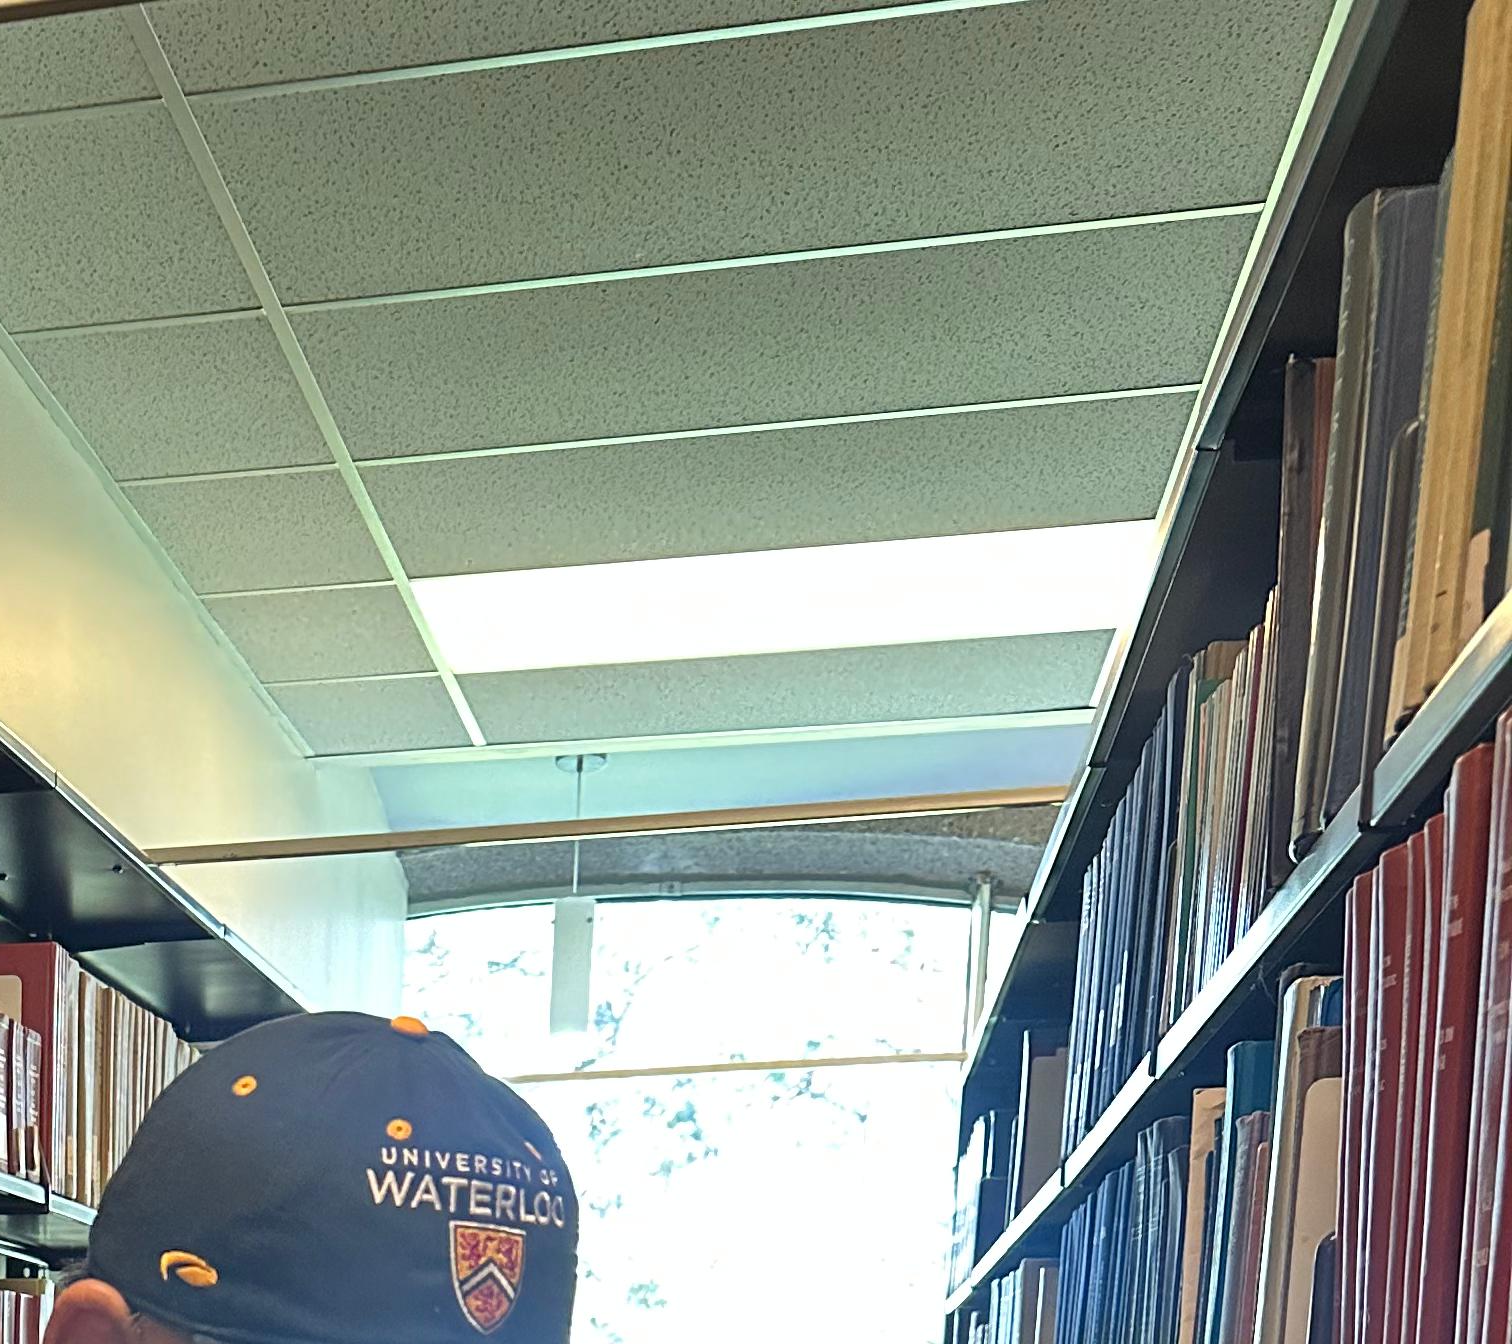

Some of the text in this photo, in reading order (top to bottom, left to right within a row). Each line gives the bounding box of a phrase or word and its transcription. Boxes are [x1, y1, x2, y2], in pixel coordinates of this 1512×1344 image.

[380, 1146, 559, 1187] UNIVERSITY OF
[365, 1167, 565, 1229] WATERLOO
